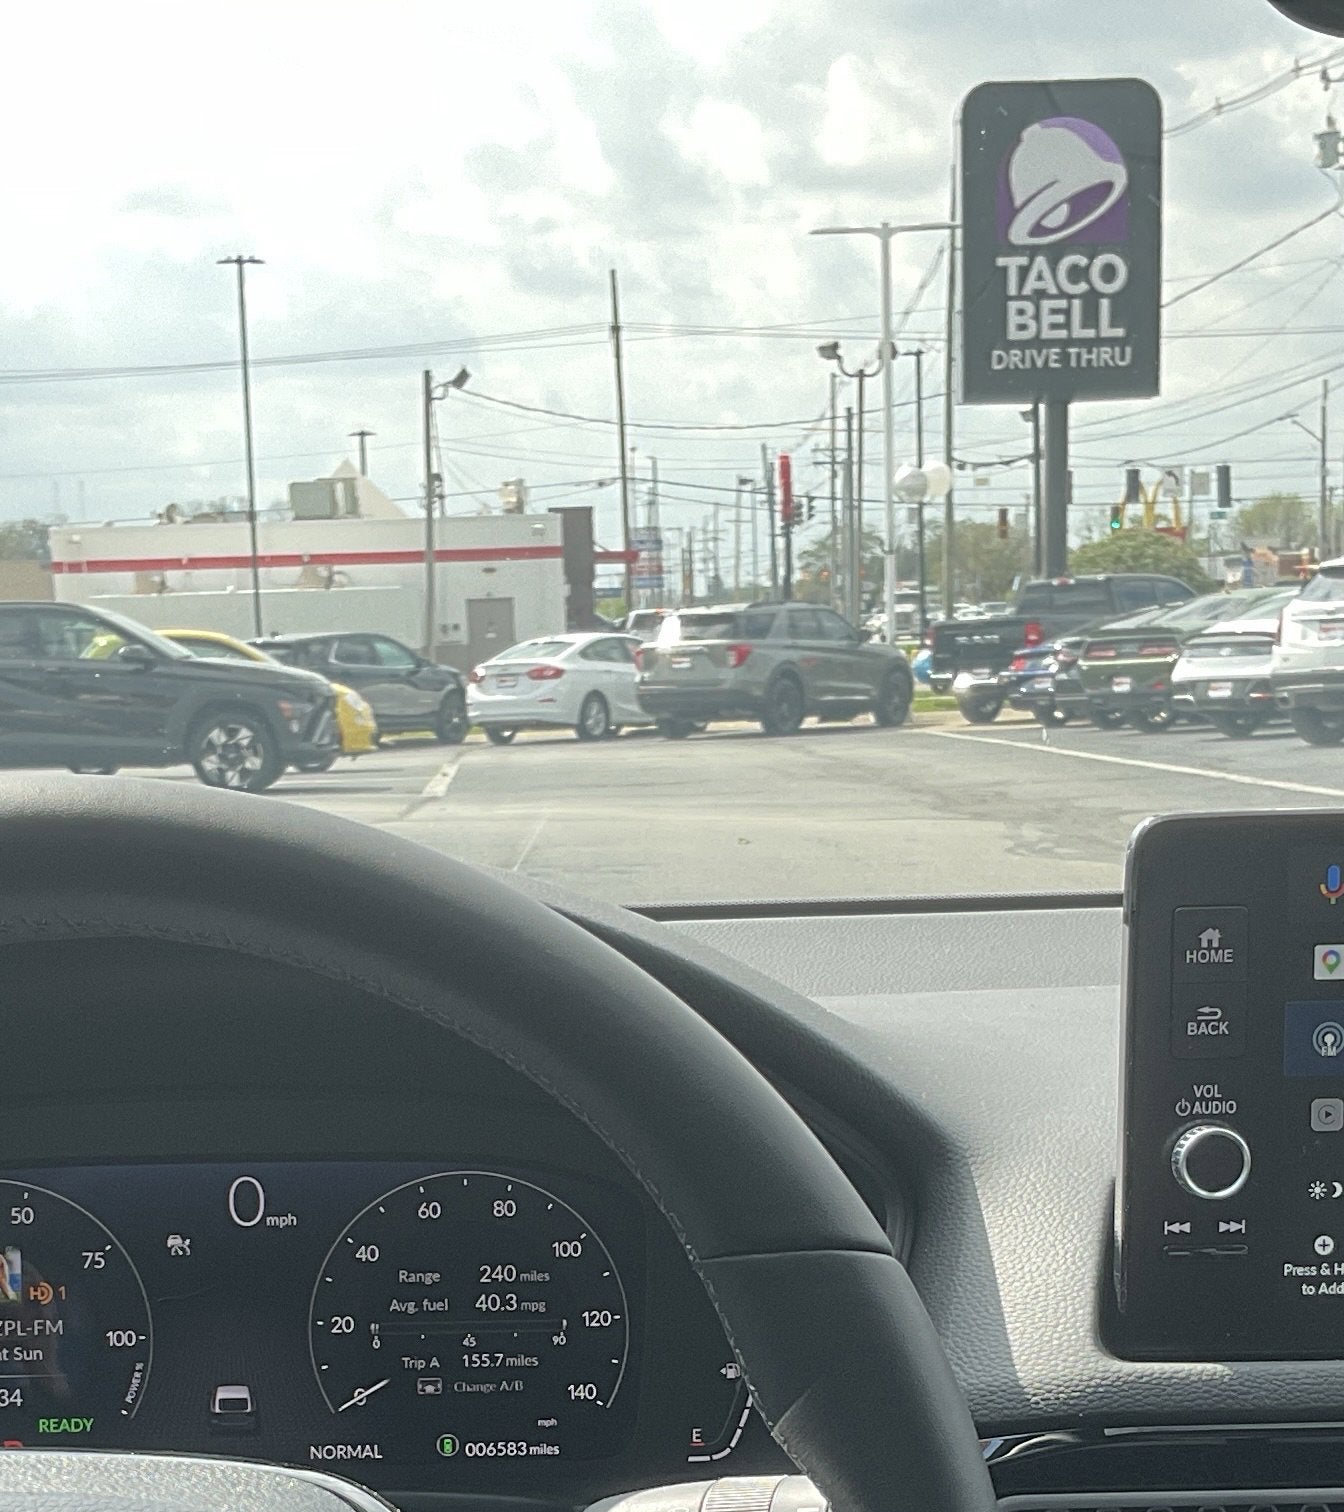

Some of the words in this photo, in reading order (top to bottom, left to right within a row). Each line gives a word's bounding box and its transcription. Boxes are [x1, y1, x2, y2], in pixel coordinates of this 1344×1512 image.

[996, 253, 1128, 296] TACO
[1007, 298, 1126, 341] BELL
[991, 349, 1062, 370] DRIVE
[1065, 346, 1132, 367] THRU
[1186, 949, 1234, 964] HOME
[1187, 1021, 1230, 1036] BACK
[1193, 1085, 1222, 1098] VOL
[1192, 1101, 1237, 1115] AUDIO
[228, 1176, 265, 1227] 0
[266, 1212, 297, 1229] mph
[417, 1202, 442, 1219] 60
[493, 1200, 517, 1217] 80
[10, 1206, 35, 1225] 50
[355, 1245, 380, 1262] 40
[552, 1241, 582, 1258] 100
[81, 1252, 106, 1269] 75
[399, 1269, 441, 1285] Range
[479, 1264, 517, 1283] 240
[520, 1270, 550, 1282] miles
[1283, 1263, 1318, 1277] Press
[1320, 1263, 1330, 1276] &
[58, 1285, 66, 1300] 1
[1302, 1283, 1315, 1295] to
[1318, 1282, 1344, 1295] Add
[389, 1299, 419, 1314] Avg.
[422, 1298, 449, 1311] fuel
[475, 1293, 518, 1312] 40.3
[520, 1301, 547, 1313] mpg
[330, 1316, 355, 1334] 20
[582, 1310, 612, 1327] 120
[106, 1330, 137, 1347] 100
[462, 1336, 477, 1348] 45
[552, 1335, 567, 1346] 90
[13, 1348, 43, 1362] Sun
[401, 1357, 426, 1371] Trip
[429, 1356, 440, 1368] A
[462, 1353, 504, 1368] 155.7
[505, 1354, 539, 1367] miles
[125, 1373, 143, 1404] POWER
[453, 1381, 497, 1393] Change
[499, 1379, 524, 1392] A/B
[567, 1383, 597, 1400] 140
[38, 1417, 95, 1433] READY
[537, 1417, 558, 1428] mph
[692, 1428, 702, 1443] E
[310, 1444, 383, 1460] NORMAL
[465, 1441, 527, 1457] 006583
[529, 1443, 560, 1456] miles
